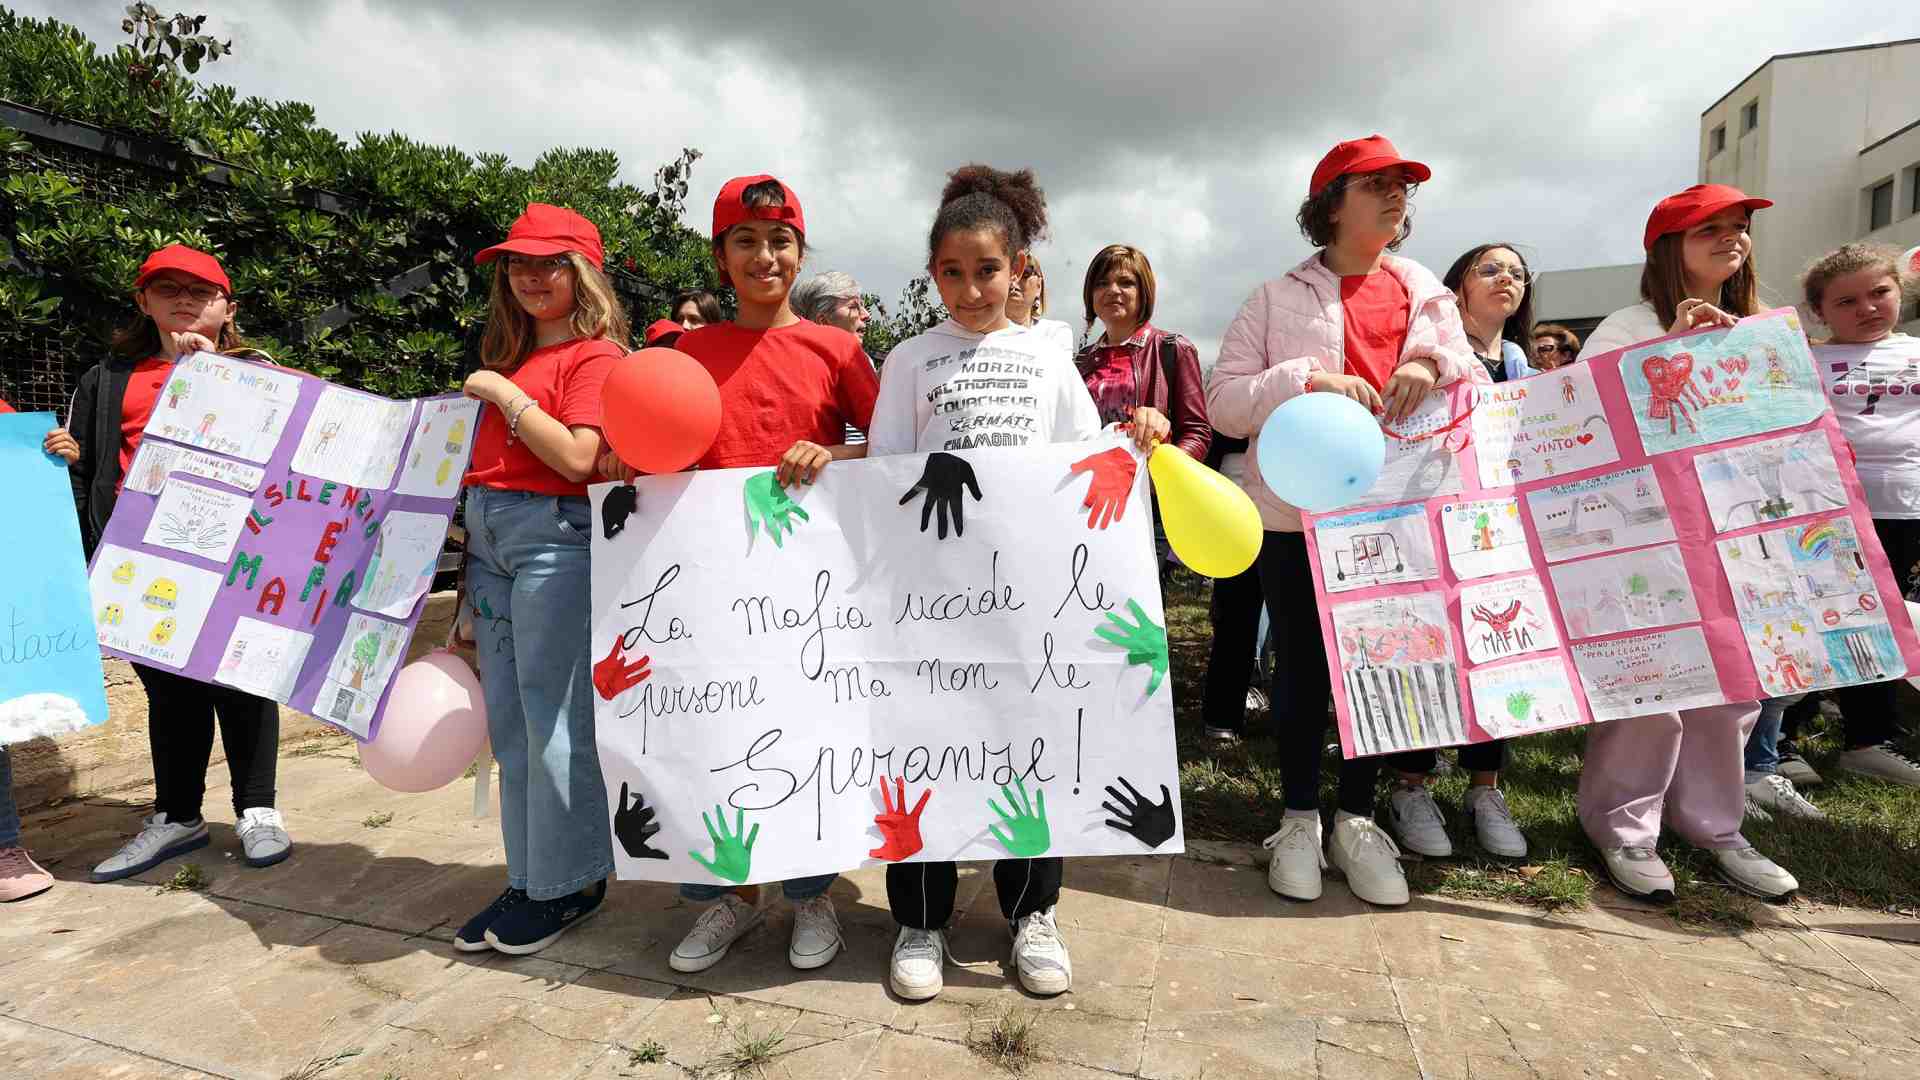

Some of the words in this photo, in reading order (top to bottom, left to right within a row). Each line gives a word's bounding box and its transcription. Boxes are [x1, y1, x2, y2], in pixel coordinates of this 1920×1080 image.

[961, 362, 1044, 378] MORZINE
[1493, 388, 1528, 402] ALLA
[944, 432, 1029, 451] CHAMONIX
[950, 413, 1036, 432] ZERMATT
[246, 509, 273, 535] IL
[264, 479, 381, 539] SILENZIO
[226, 551, 355, 625] MAFIA
[620, 563, 693, 651] La
[731, 568, 873, 680] mafia
[895, 549, 1025, 627] uccide
[1052, 543, 1116, 619] le
[0, 605, 88, 665] tari
[1481, 626, 1534, 655] MAFIA
[619, 674, 767, 755] persone
[824, 665, 891, 703] ma
[916, 656, 999, 692] non
[1030, 631, 1092, 695] le
